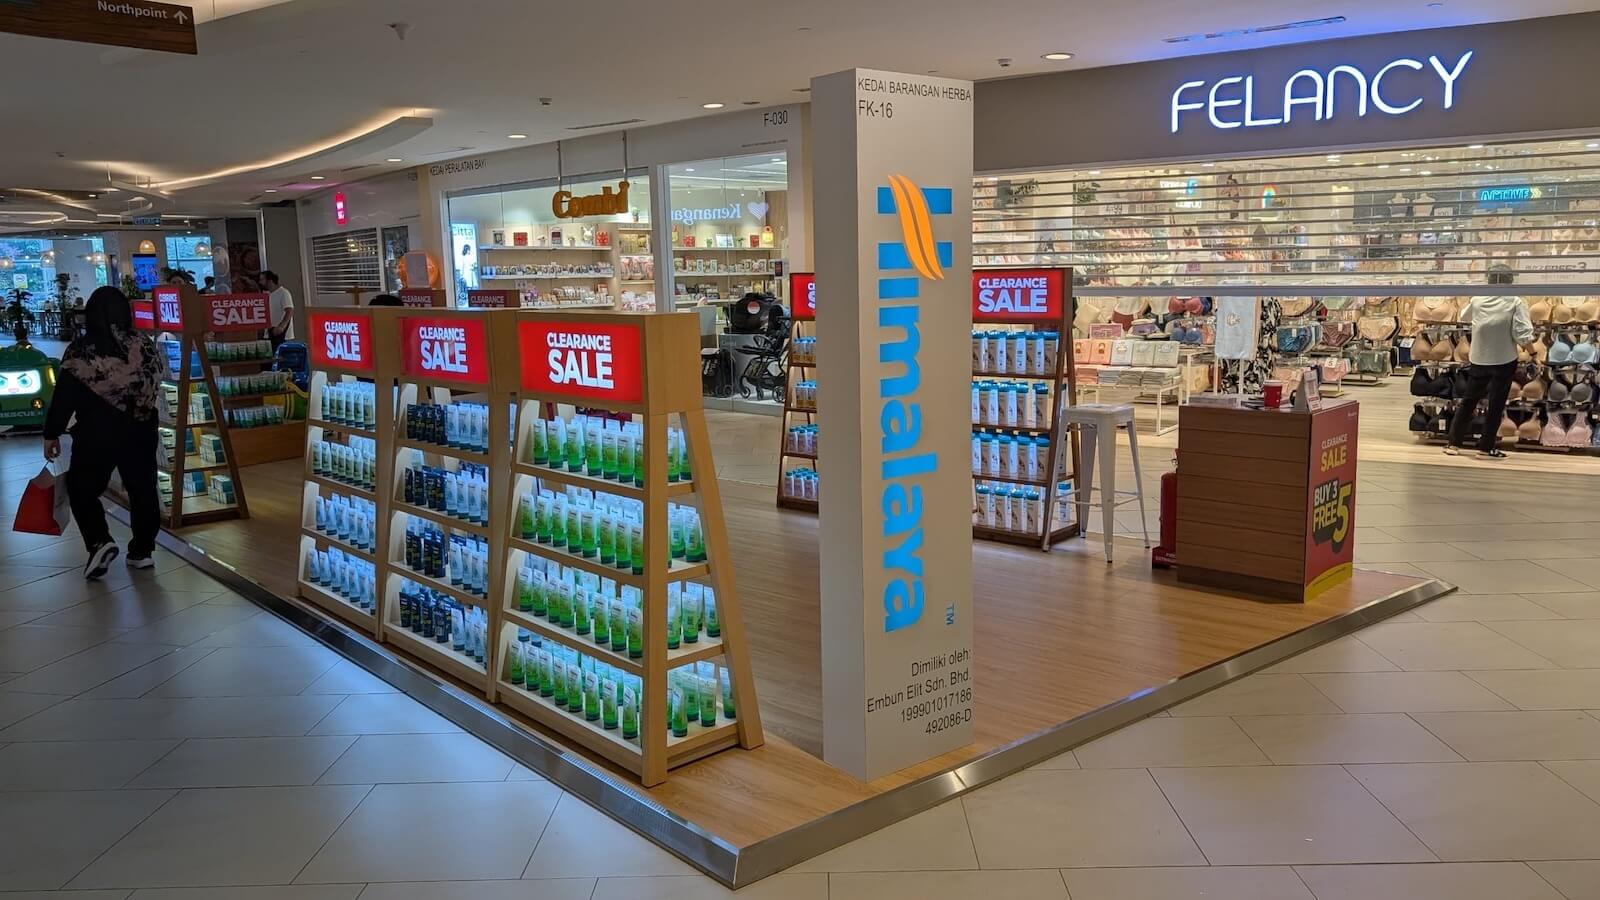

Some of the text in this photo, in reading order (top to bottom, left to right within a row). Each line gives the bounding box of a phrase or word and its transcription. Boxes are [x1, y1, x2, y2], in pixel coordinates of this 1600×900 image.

[97, 0, 168, 18] Northpoint
[858, 77, 971, 101] KEDAI BARANGAN HERBA
[1171, 50, 1474, 133] FELANCY
[763, 110, 788, 126] F-030
[858, 100, 893, 119] FK-16
[552, 181, 630, 218] Combi
[979, 277, 1047, 289] CLEARANCE
[212, 299, 265, 308] CLEARANCE
[401, 295, 432, 303] CLEARANCE
[470, 295, 504, 304] CLEARANCE
[978, 289, 1048, 312] SALE
[159, 302, 181, 324] SALE
[213, 307, 267, 325] SALE
[324, 321, 359, 334] CLEARANCE
[419, 326, 466, 341] CLEARANCE
[325, 333, 361, 361] SALE
[547, 332, 611, 351] CLEARANCE
[420, 340, 468, 373] SALE
[548, 348, 614, 389] SALE
[877, 174, 952, 632] Himalaya
[1321, 433, 1348, 449] CLEARANCE
[1320, 446, 1347, 472] SALE
[1314, 480, 1338, 506] BUY 3
[1313, 484, 1352, 543] FREE 5
[911, 648, 971, 676] Dimiliki oleh:
[867, 667, 971, 713] Embun Elit Sdn. Bhd.
[900, 687, 972, 723] 199901017186
[925, 708, 972, 735] 492086-D
